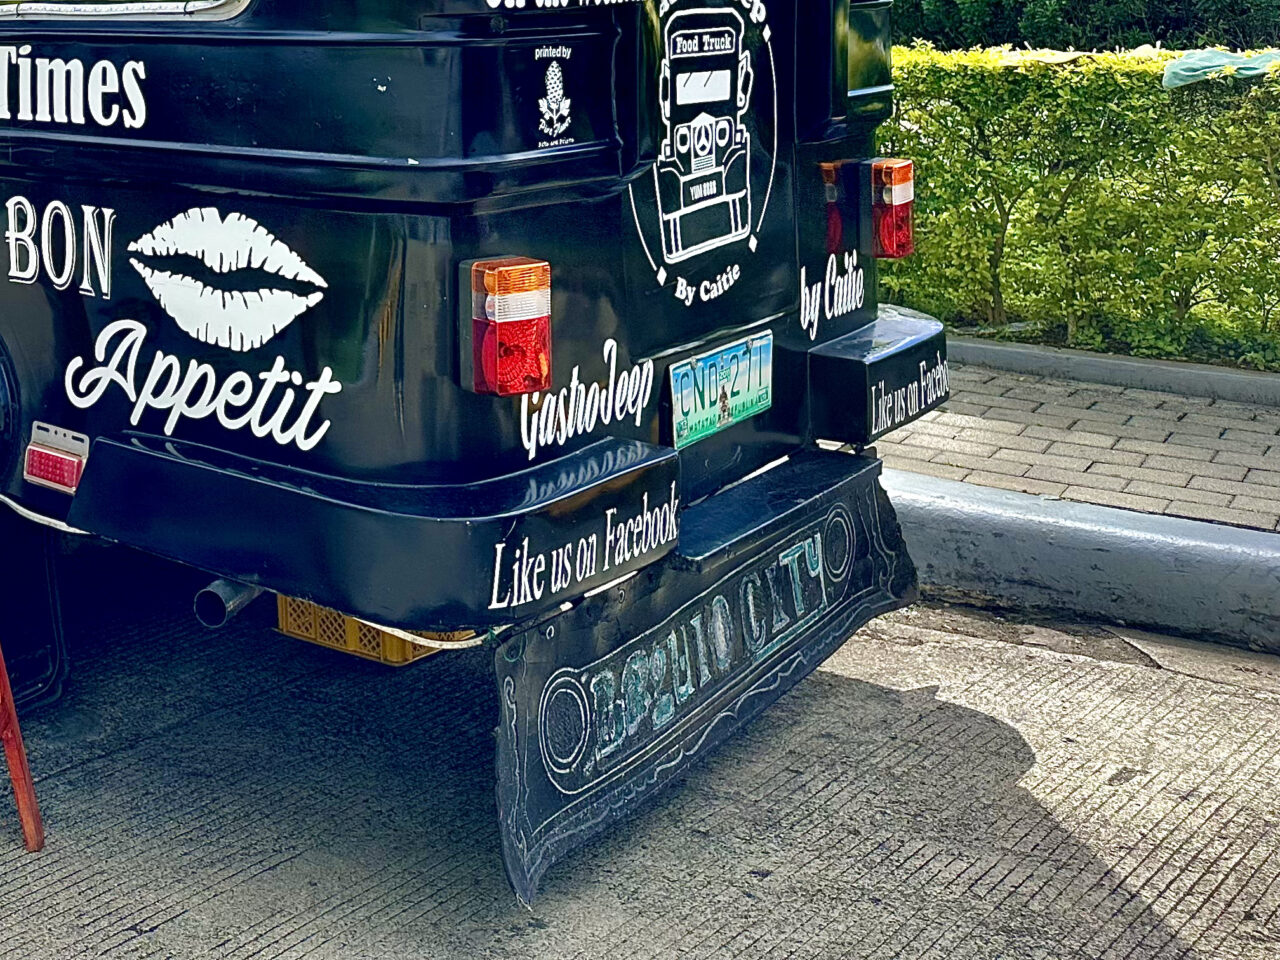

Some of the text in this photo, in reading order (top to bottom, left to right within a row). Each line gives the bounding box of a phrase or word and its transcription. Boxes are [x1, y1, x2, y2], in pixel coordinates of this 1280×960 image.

[534, 45, 572, 61] printed by
[675, 33, 732, 54] Food Truck
[4, 195, 117, 300] BON
[674, 262, 742, 307] By Caitie
[799, 268, 823, 339] by
[823, 248, 865, 331] Caitie
[64, 318, 343, 452] Appetit
[680, 362, 719, 418] CND
[728, 343, 763, 399] 271
[871, 379, 894, 436] Like
[893, 387, 906, 424] us
[907, 380, 920, 417] on
[487, 480, 680, 610] Like us on Facebook
